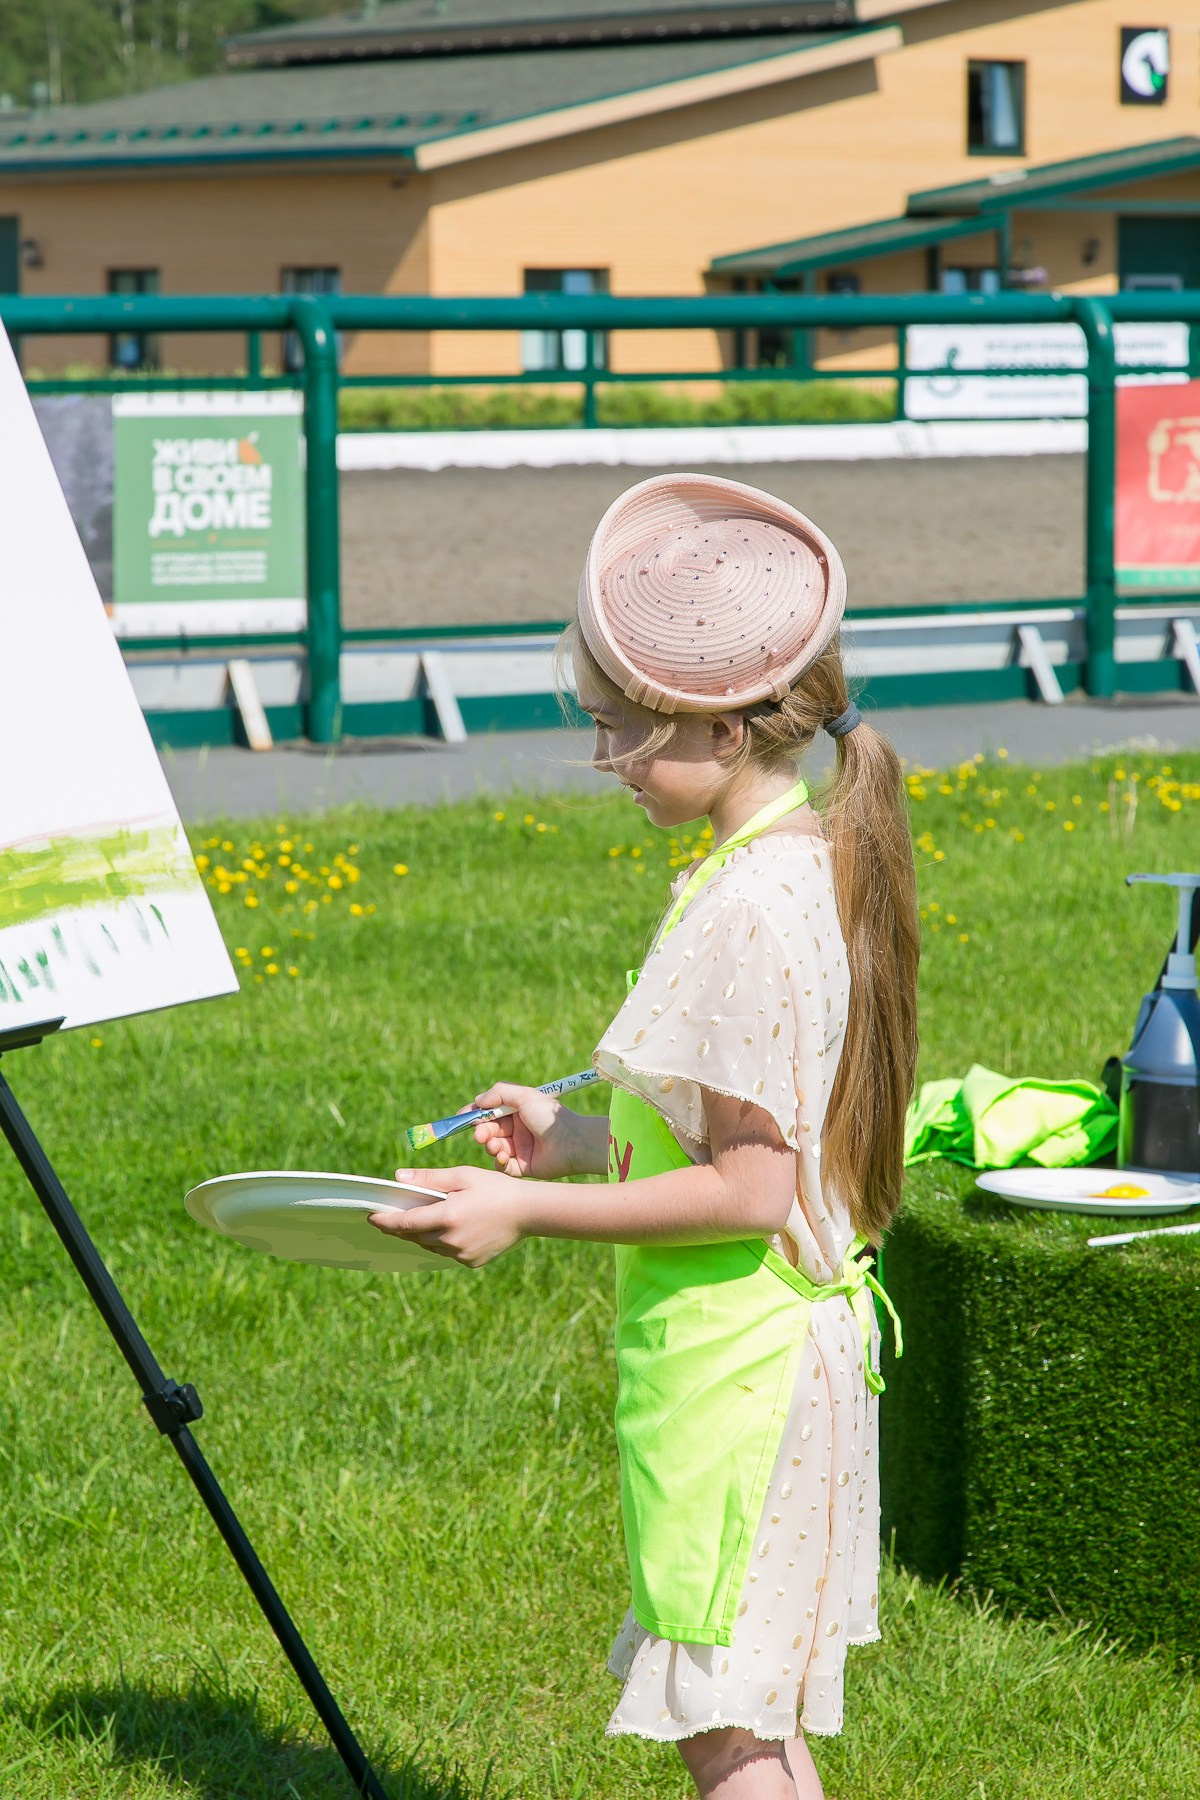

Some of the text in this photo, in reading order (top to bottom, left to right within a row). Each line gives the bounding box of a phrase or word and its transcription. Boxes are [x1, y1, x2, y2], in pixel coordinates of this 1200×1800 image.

[152, 438, 239, 464] ЖИВИ
[152, 463, 272, 492] В СВОЕМ
[148, 492, 272, 537] ДОМЕ
[567, 1079, 577, 1087] by
